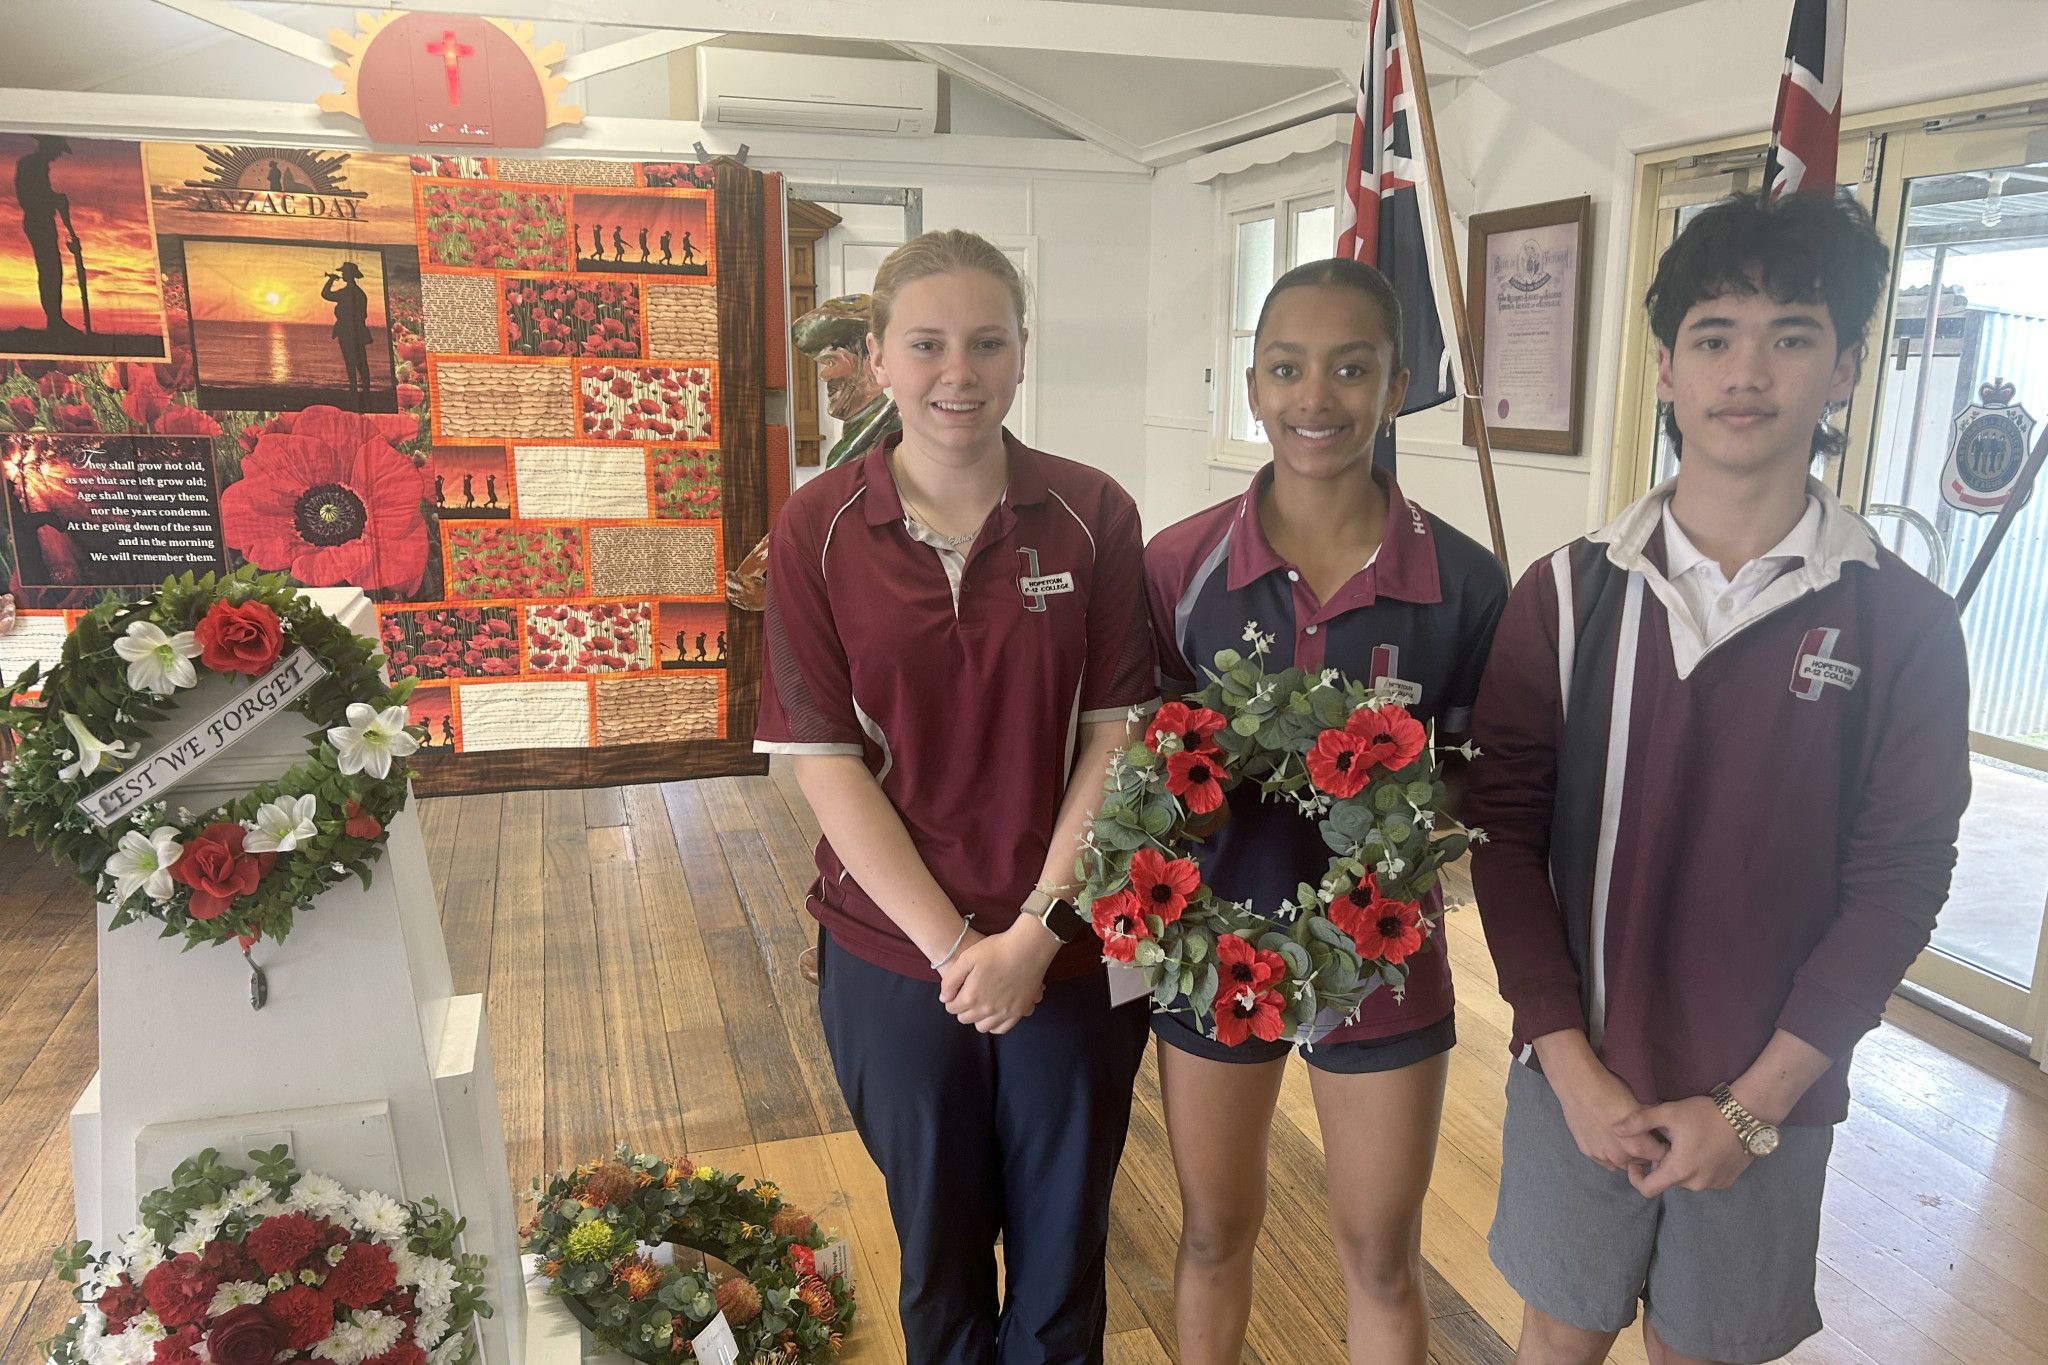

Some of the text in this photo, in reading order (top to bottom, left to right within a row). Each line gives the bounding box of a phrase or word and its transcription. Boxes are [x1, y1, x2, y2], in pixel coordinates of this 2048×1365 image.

[193, 190, 361, 219] ANZAC DAY
[73, 449, 205, 473] They shall grow not old,
[65, 475, 207, 489] as we that are left grow old;
[77, 490, 209, 503] Age shall not weary them,
[91, 506, 210, 518] nor the years condemn.
[67, 521, 212, 533] At the going down of the sun
[118, 536, 215, 549] and in the morning
[89, 552, 216, 563] We will remember them.
[1029, 578, 1062, 587] HOPETOUN
[1041, 583, 1069, 591] COLLEGE
[1804, 667, 1821, 676] P-12
[1812, 660, 1854, 677] HOPETOUN
[98, 656, 303, 818] LEST WE FORGET
